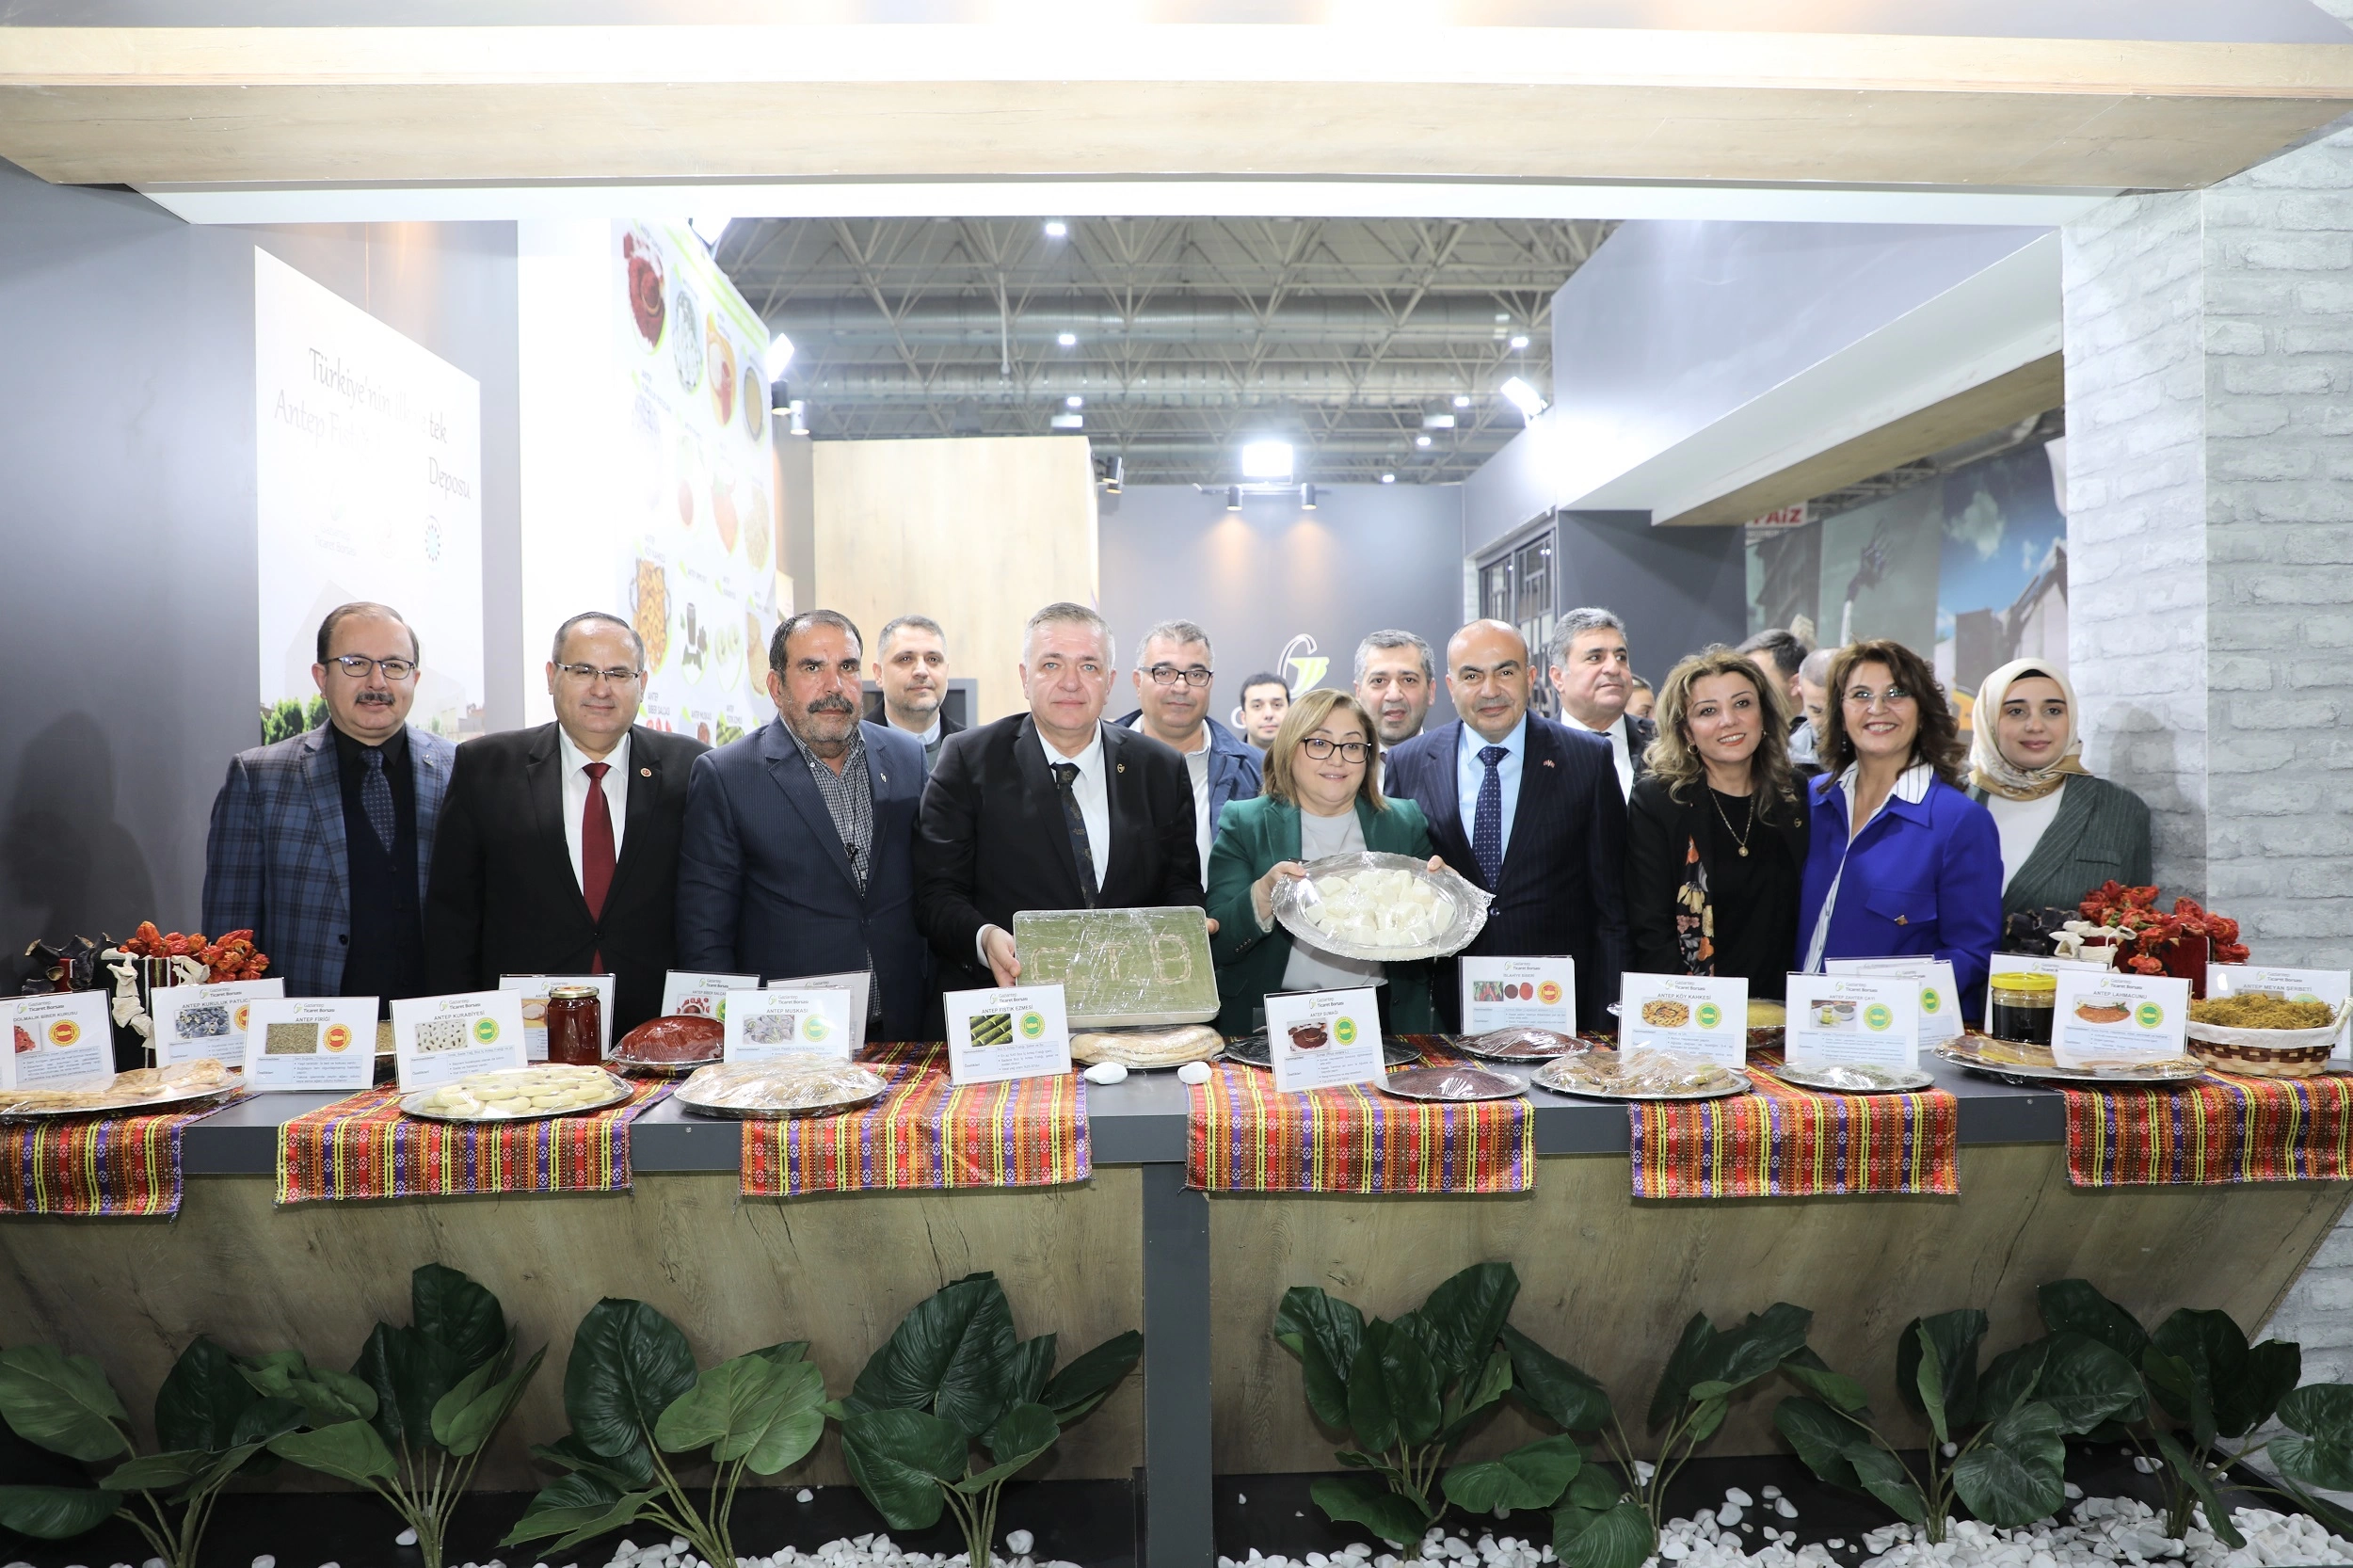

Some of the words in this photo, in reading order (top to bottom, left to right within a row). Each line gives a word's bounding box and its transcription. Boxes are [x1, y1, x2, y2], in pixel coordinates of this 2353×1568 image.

[274, 389, 325, 449] Antep
[309, 347, 392, 417] Türkiye'nin
[429, 411, 448, 444] tek
[428, 456, 472, 501] Deposu
[314, 535, 335, 552] Ticaret
